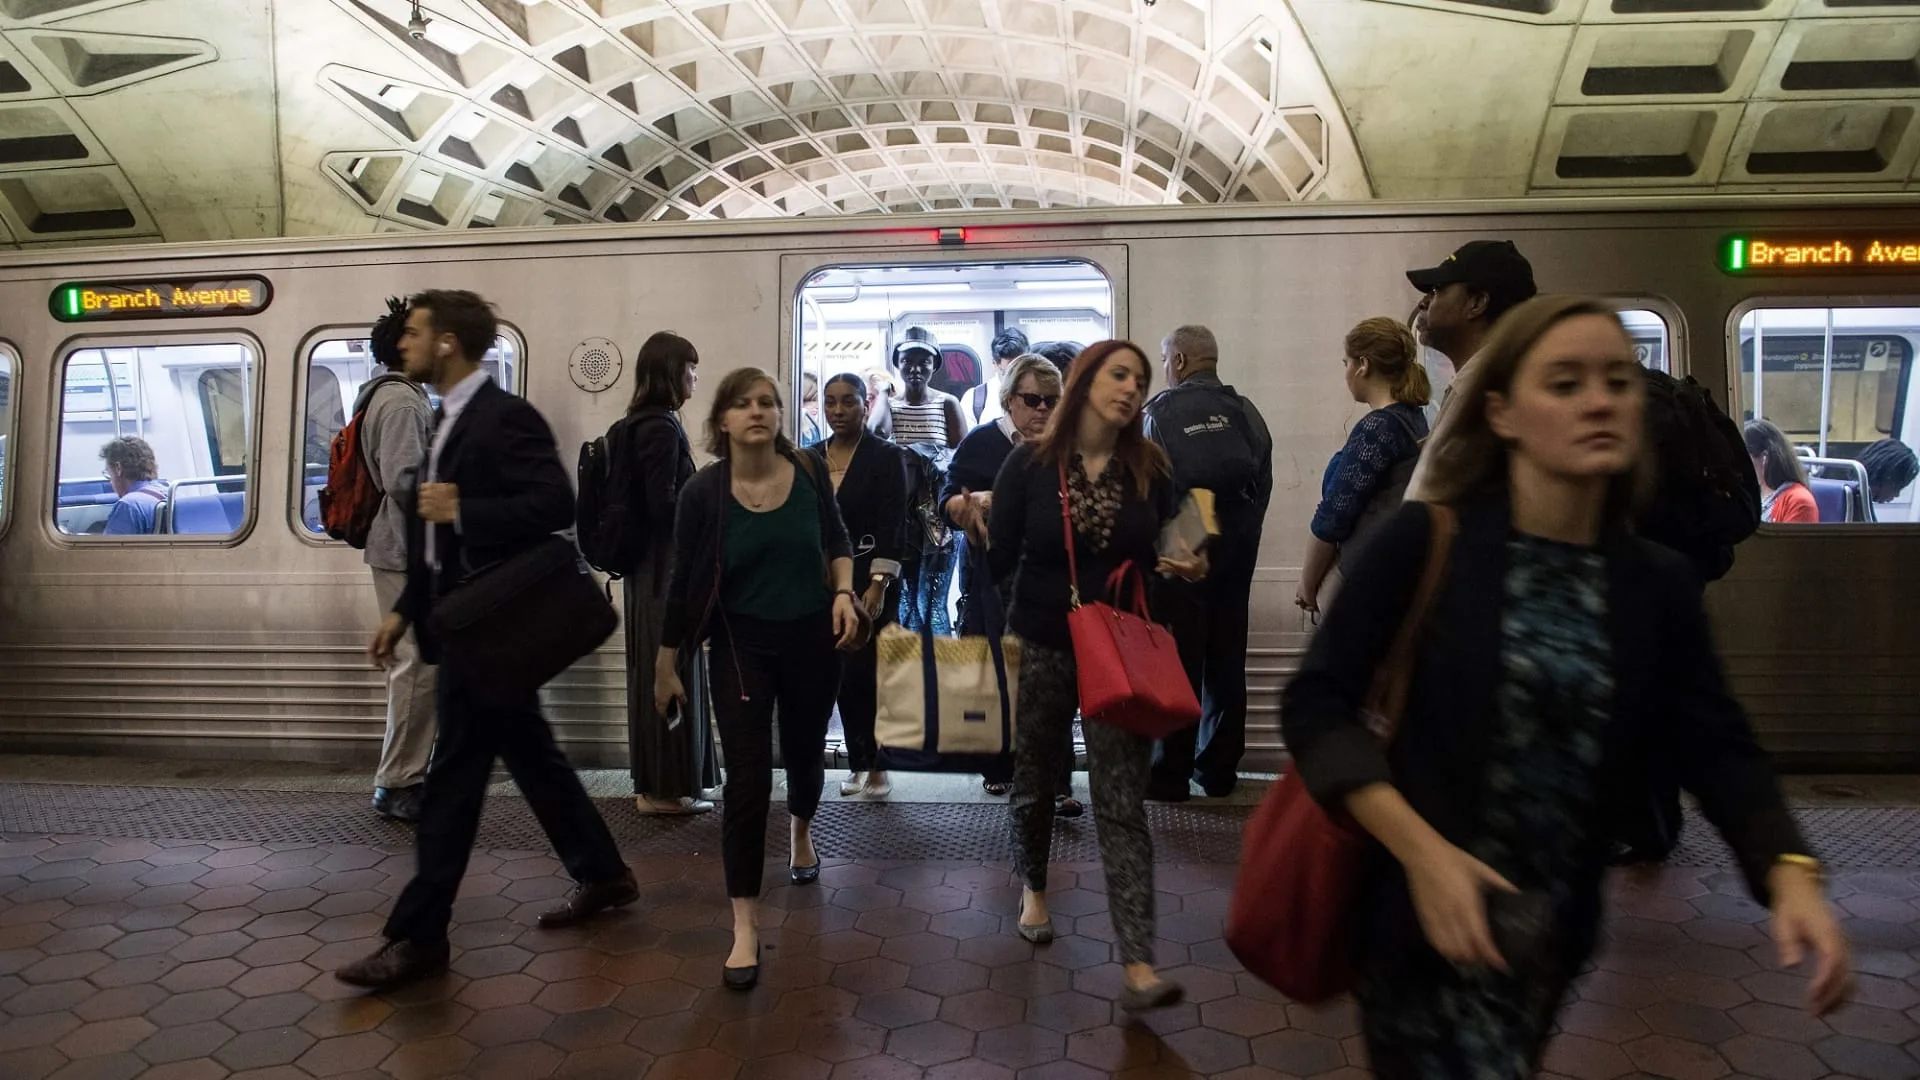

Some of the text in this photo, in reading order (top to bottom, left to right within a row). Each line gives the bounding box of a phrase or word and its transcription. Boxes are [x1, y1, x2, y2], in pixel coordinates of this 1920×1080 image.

[1750, 240, 1920, 264] Branch Ave
[82, 287, 252, 309] Branch Avenue
